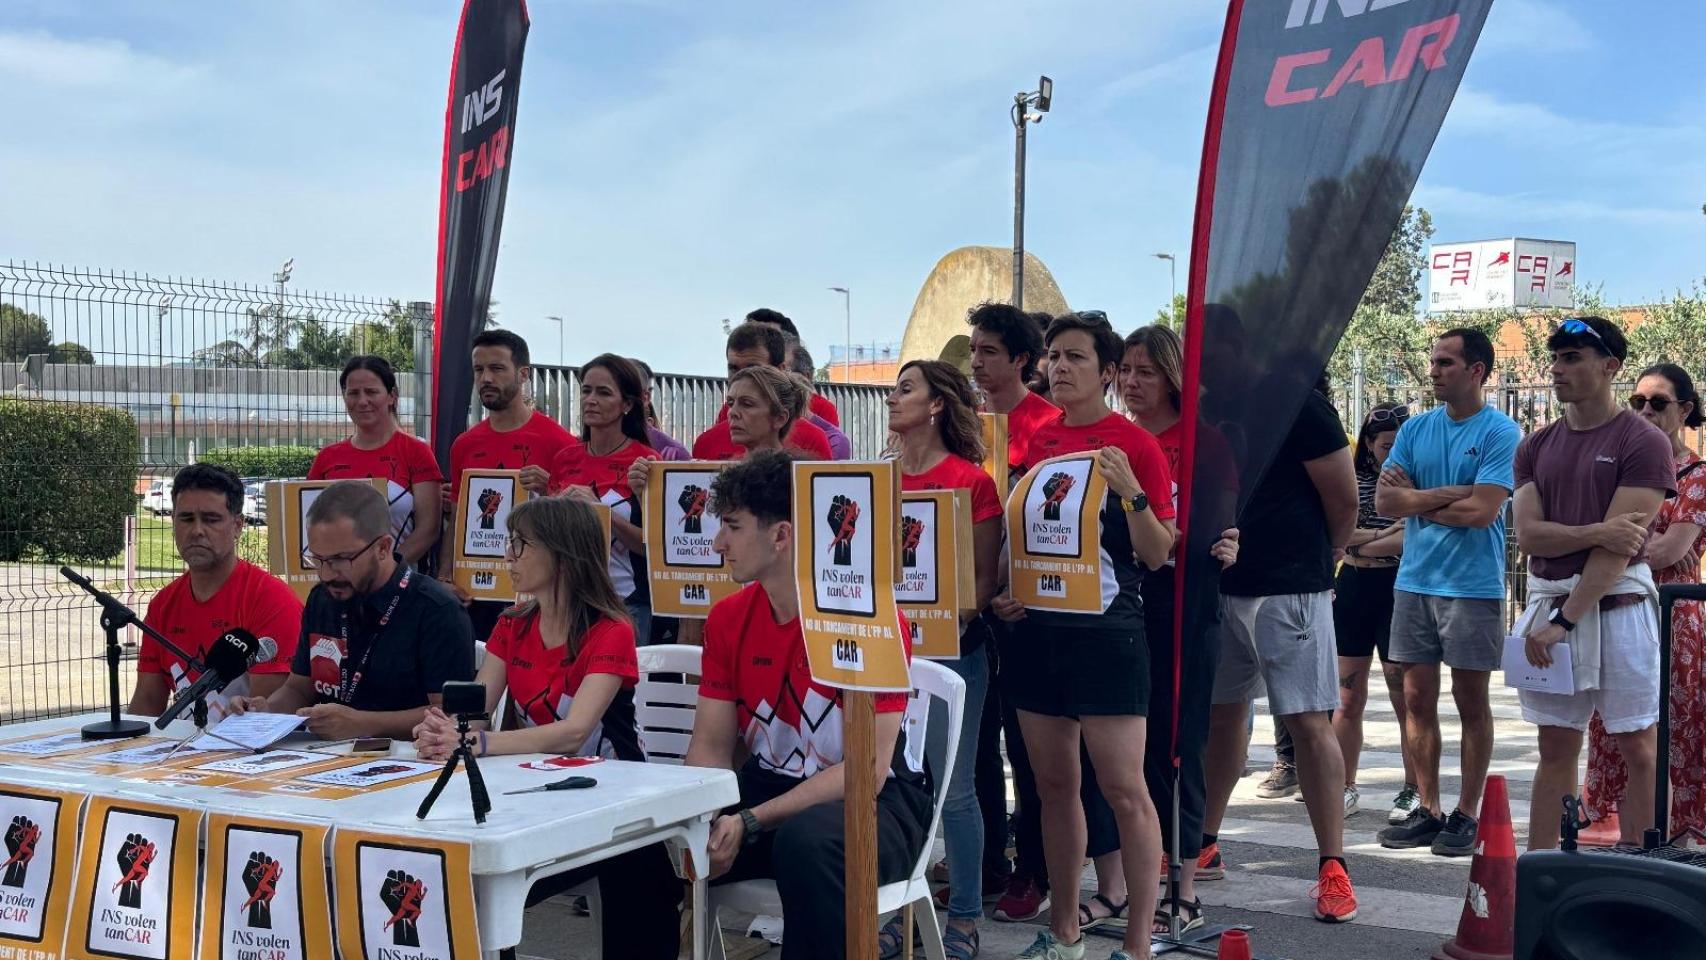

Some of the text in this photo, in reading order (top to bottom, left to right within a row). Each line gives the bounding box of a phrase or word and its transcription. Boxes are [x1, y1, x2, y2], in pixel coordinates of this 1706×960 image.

[1265, 13, 1461, 107] CAR
[461, 68, 507, 134] INS
[455, 125, 510, 192] CAR
[1032, 522, 1072, 534] INS volen
[672, 535, 713, 546] INS volen
[1036, 534, 1068, 545] tanCAR
[676, 546, 710, 556] tanCAR
[475, 571, 494, 586] CAR
[822, 567, 864, 584] INS volen
[1041, 573, 1062, 592] CAR
[684, 583, 705, 600] CAR
[827, 584, 862, 599] tanCAR
[895, 580, 924, 592] anCAR
[225, 633, 249, 653] acn
[836, 638, 858, 663] CAR
[315, 680, 341, 699] CGT
[5, 893, 35, 908] volen
[101, 908, 157, 930] INS volen
[104, 926, 152, 944] tanCAR
[232, 929, 290, 950] INS volen
[378, 947, 401, 960] INS
